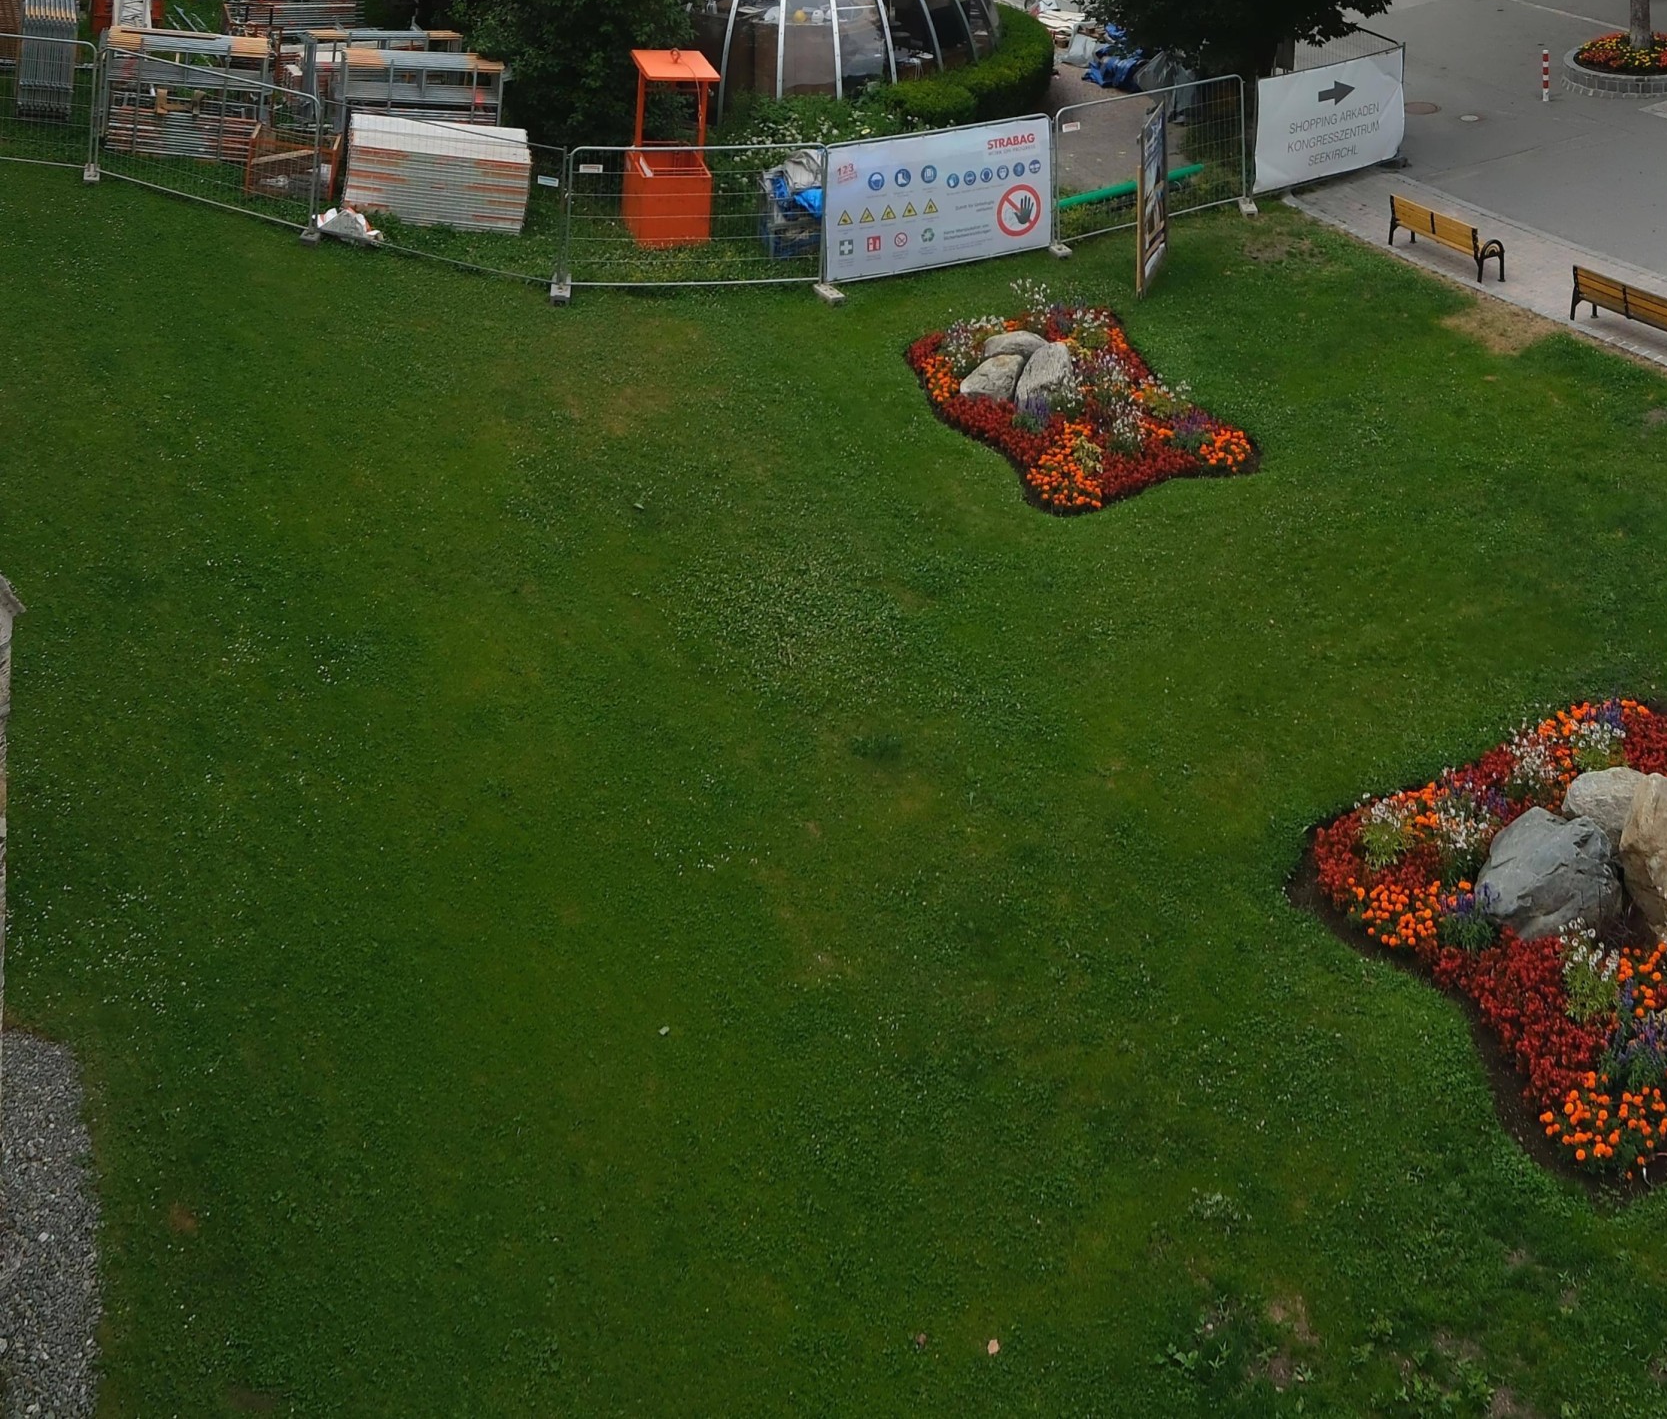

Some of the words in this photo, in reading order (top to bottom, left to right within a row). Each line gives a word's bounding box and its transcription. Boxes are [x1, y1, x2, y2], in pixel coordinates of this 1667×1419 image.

[1289, 113, 1338, 135] SHOPPING
[1339, 101, 1380, 122] ARKADEN
[987, 132, 1036, 150] STRABAG
[1287, 120, 1380, 154] KONGRESSZENTRUM
[1307, 144, 1359, 167] SEEKIRCHL
